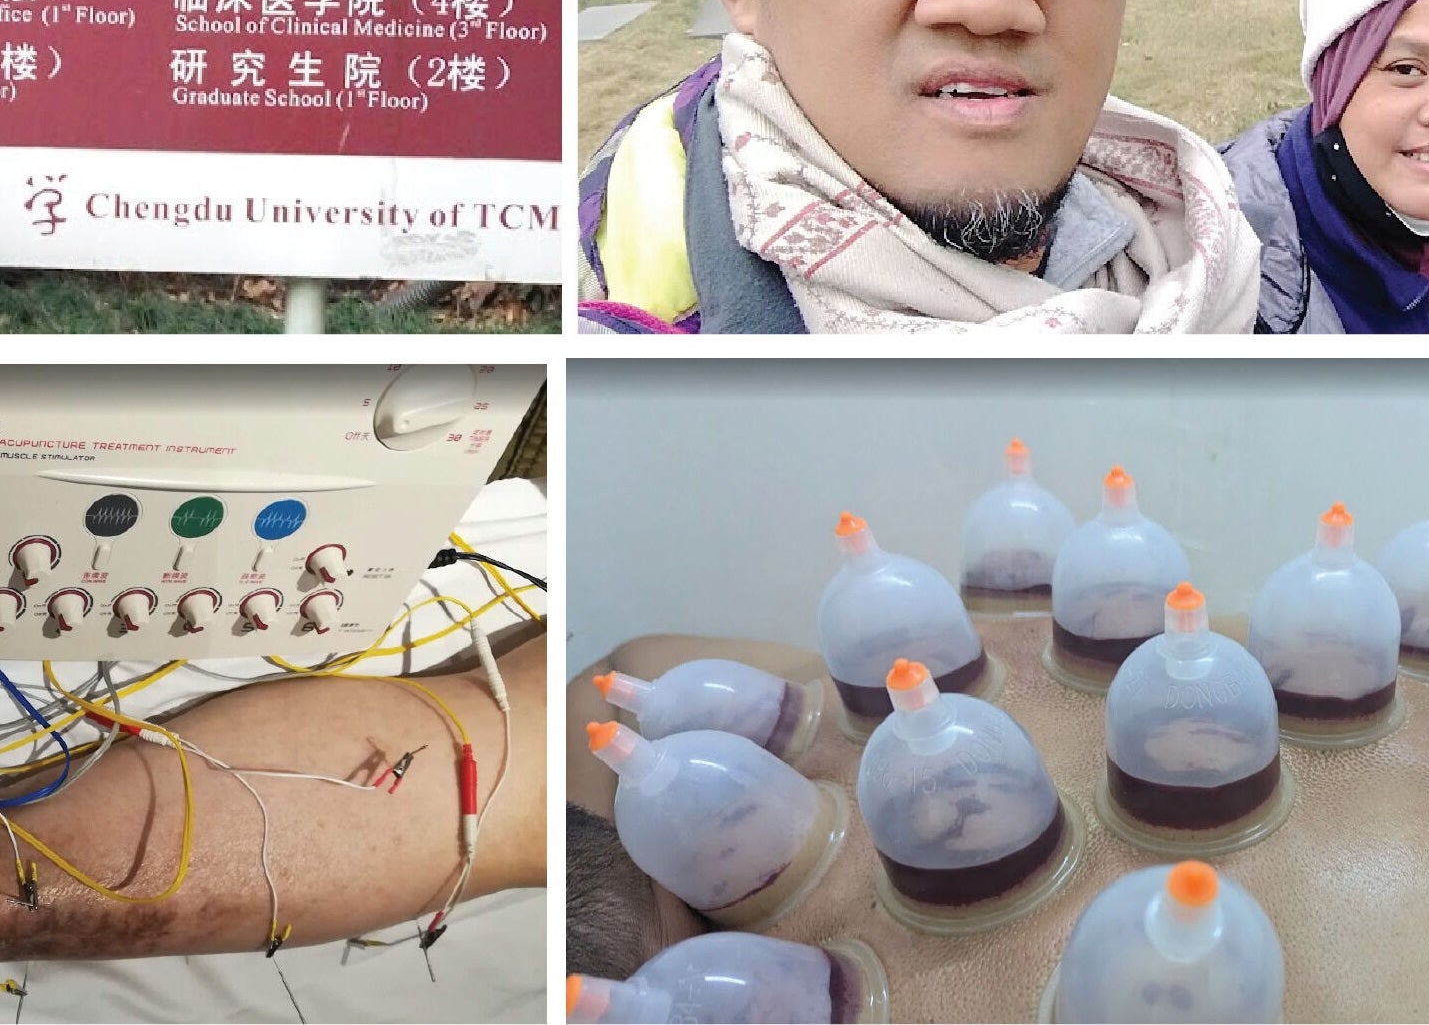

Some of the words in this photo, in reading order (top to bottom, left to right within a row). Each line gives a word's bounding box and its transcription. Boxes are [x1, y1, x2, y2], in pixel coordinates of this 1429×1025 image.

[76, 5, 136, 29] Floor)
[175, 14, 242, 33] School
[246, 14, 270, 34] of
[271, 15, 349, 35] Clinical
[359, 16, 445, 38] Medicine
[485, 19, 548, 42] Floor)
[172, 87, 259, 106] Graduate
[264, 88, 331, 108] School
[367, 90, 428, 112] Floor)
[85, 191, 234, 227] Chengdu
[246, 195, 414, 233] University
[429, 197, 464, 228] of
[473, 202, 560, 232] TCM
[0, 438, 87, 451] ACUPUNCTURE
[93, 441, 162, 452] TREATMENT
[165, 444, 238, 456] INSTRUMENT
[0, 451, 39, 461] MUSCLE
[40, 453, 97, 462] STIMULATOR
